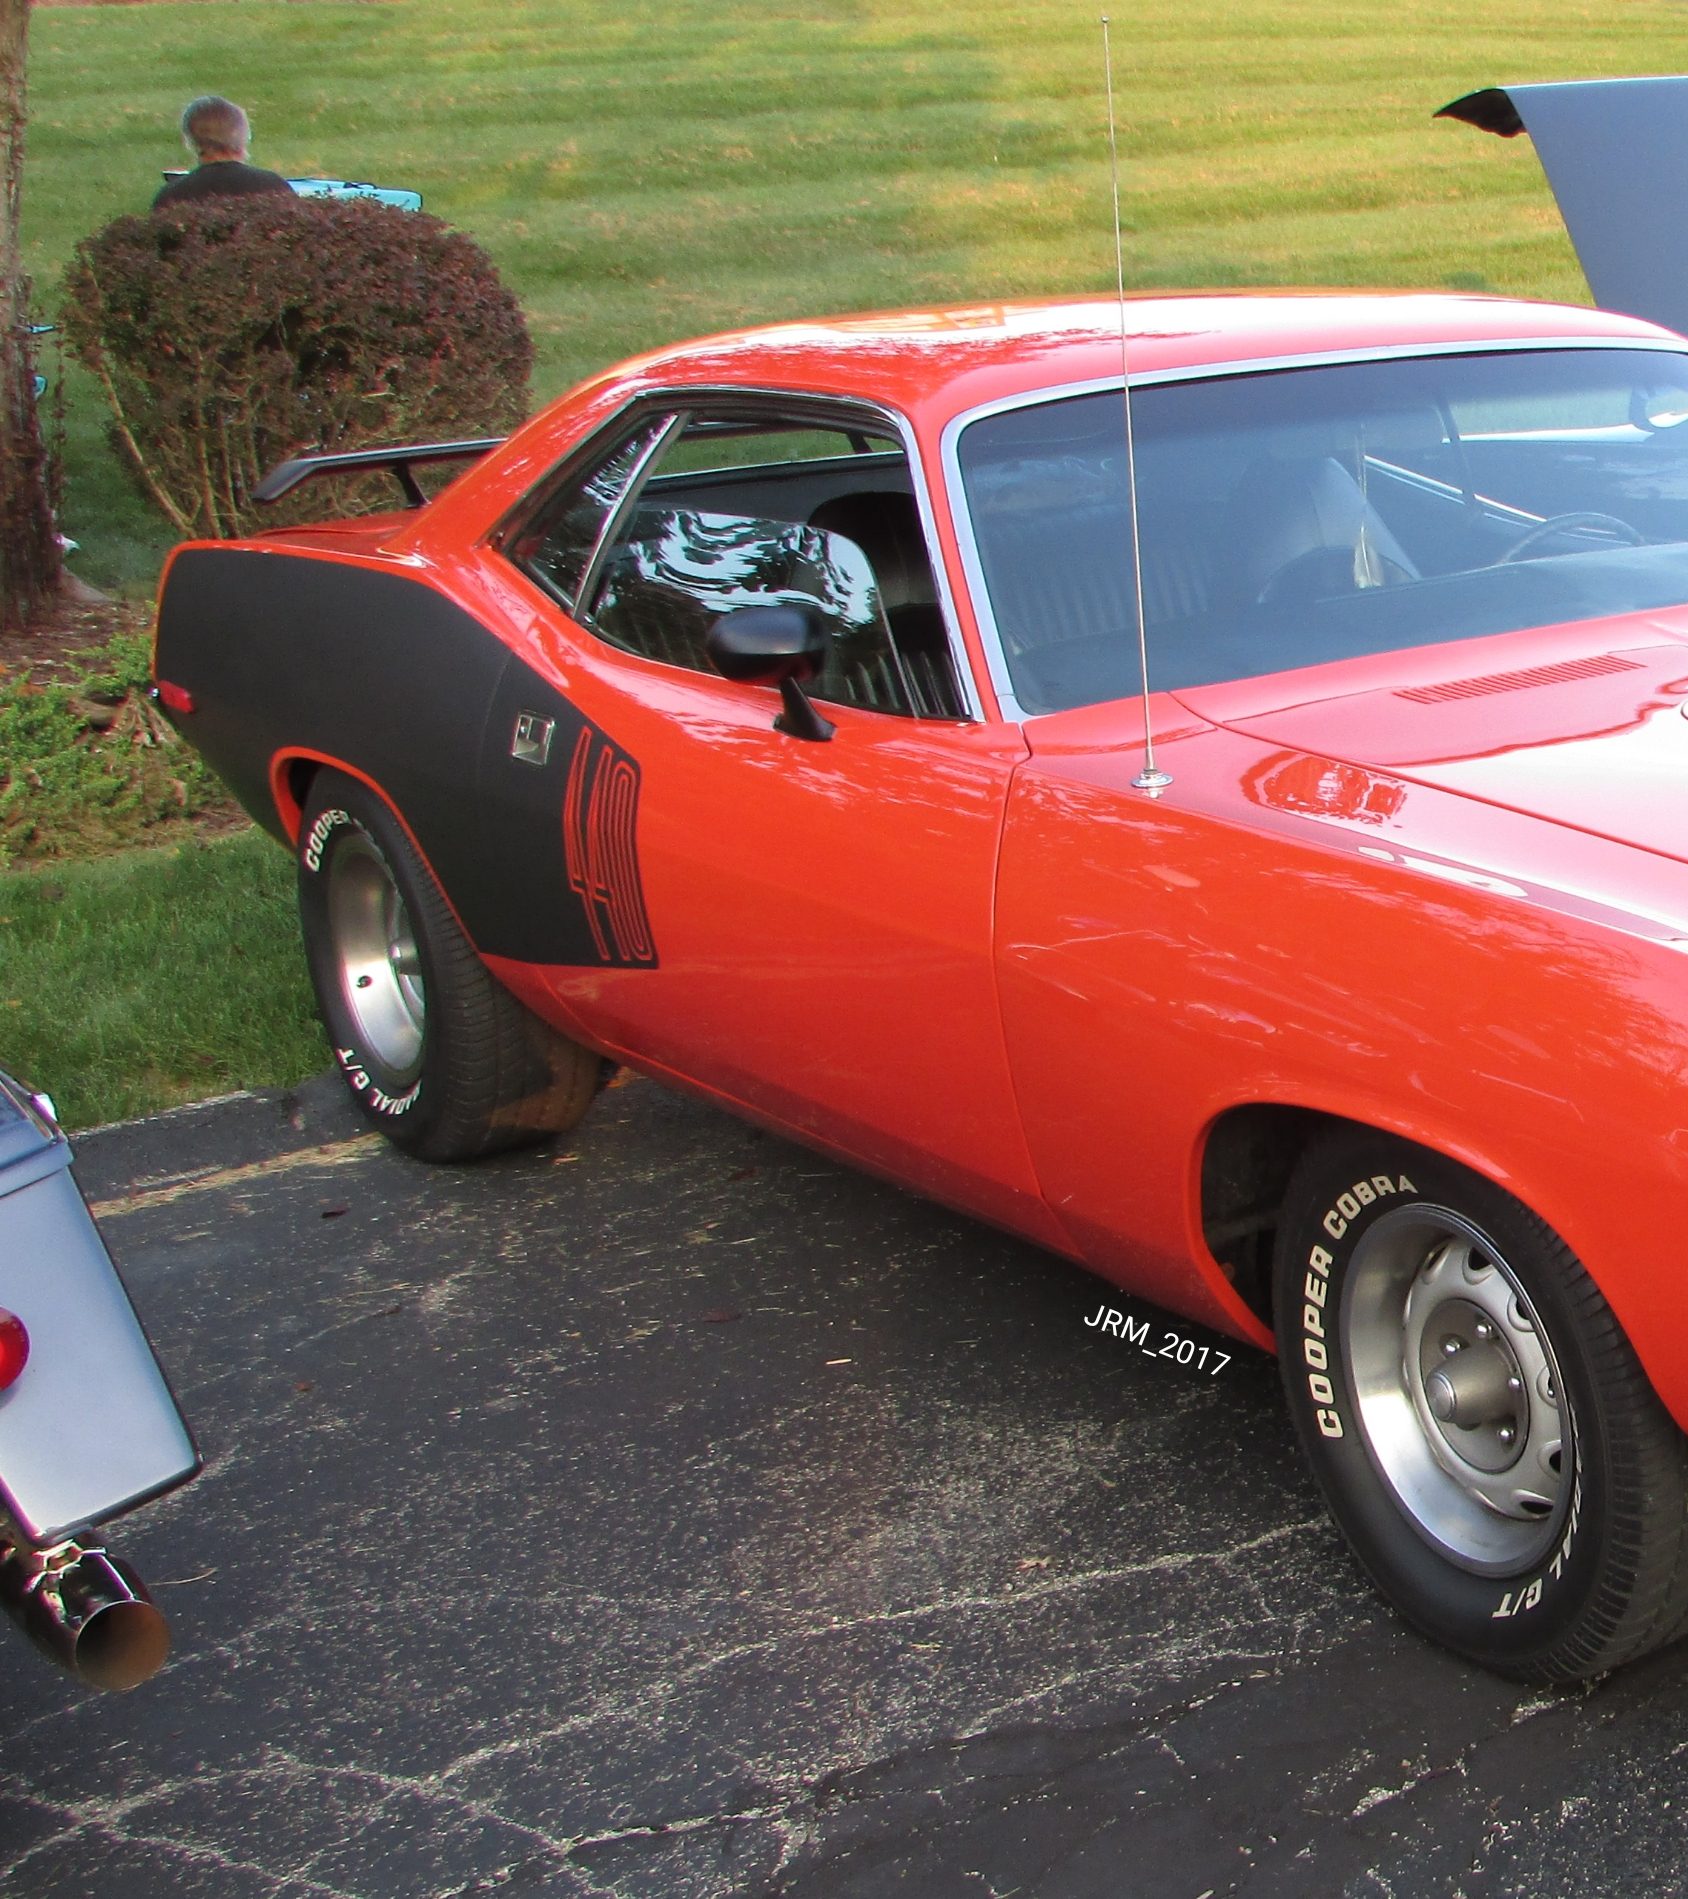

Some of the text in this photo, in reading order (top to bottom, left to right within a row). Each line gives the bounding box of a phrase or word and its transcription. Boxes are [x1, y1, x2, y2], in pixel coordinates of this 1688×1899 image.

[337, 1047, 371, 1091] G/T
[1303, 1175, 1419, 1439] COOPER COBRA
[1491, 1578, 1543, 1618] G/T
